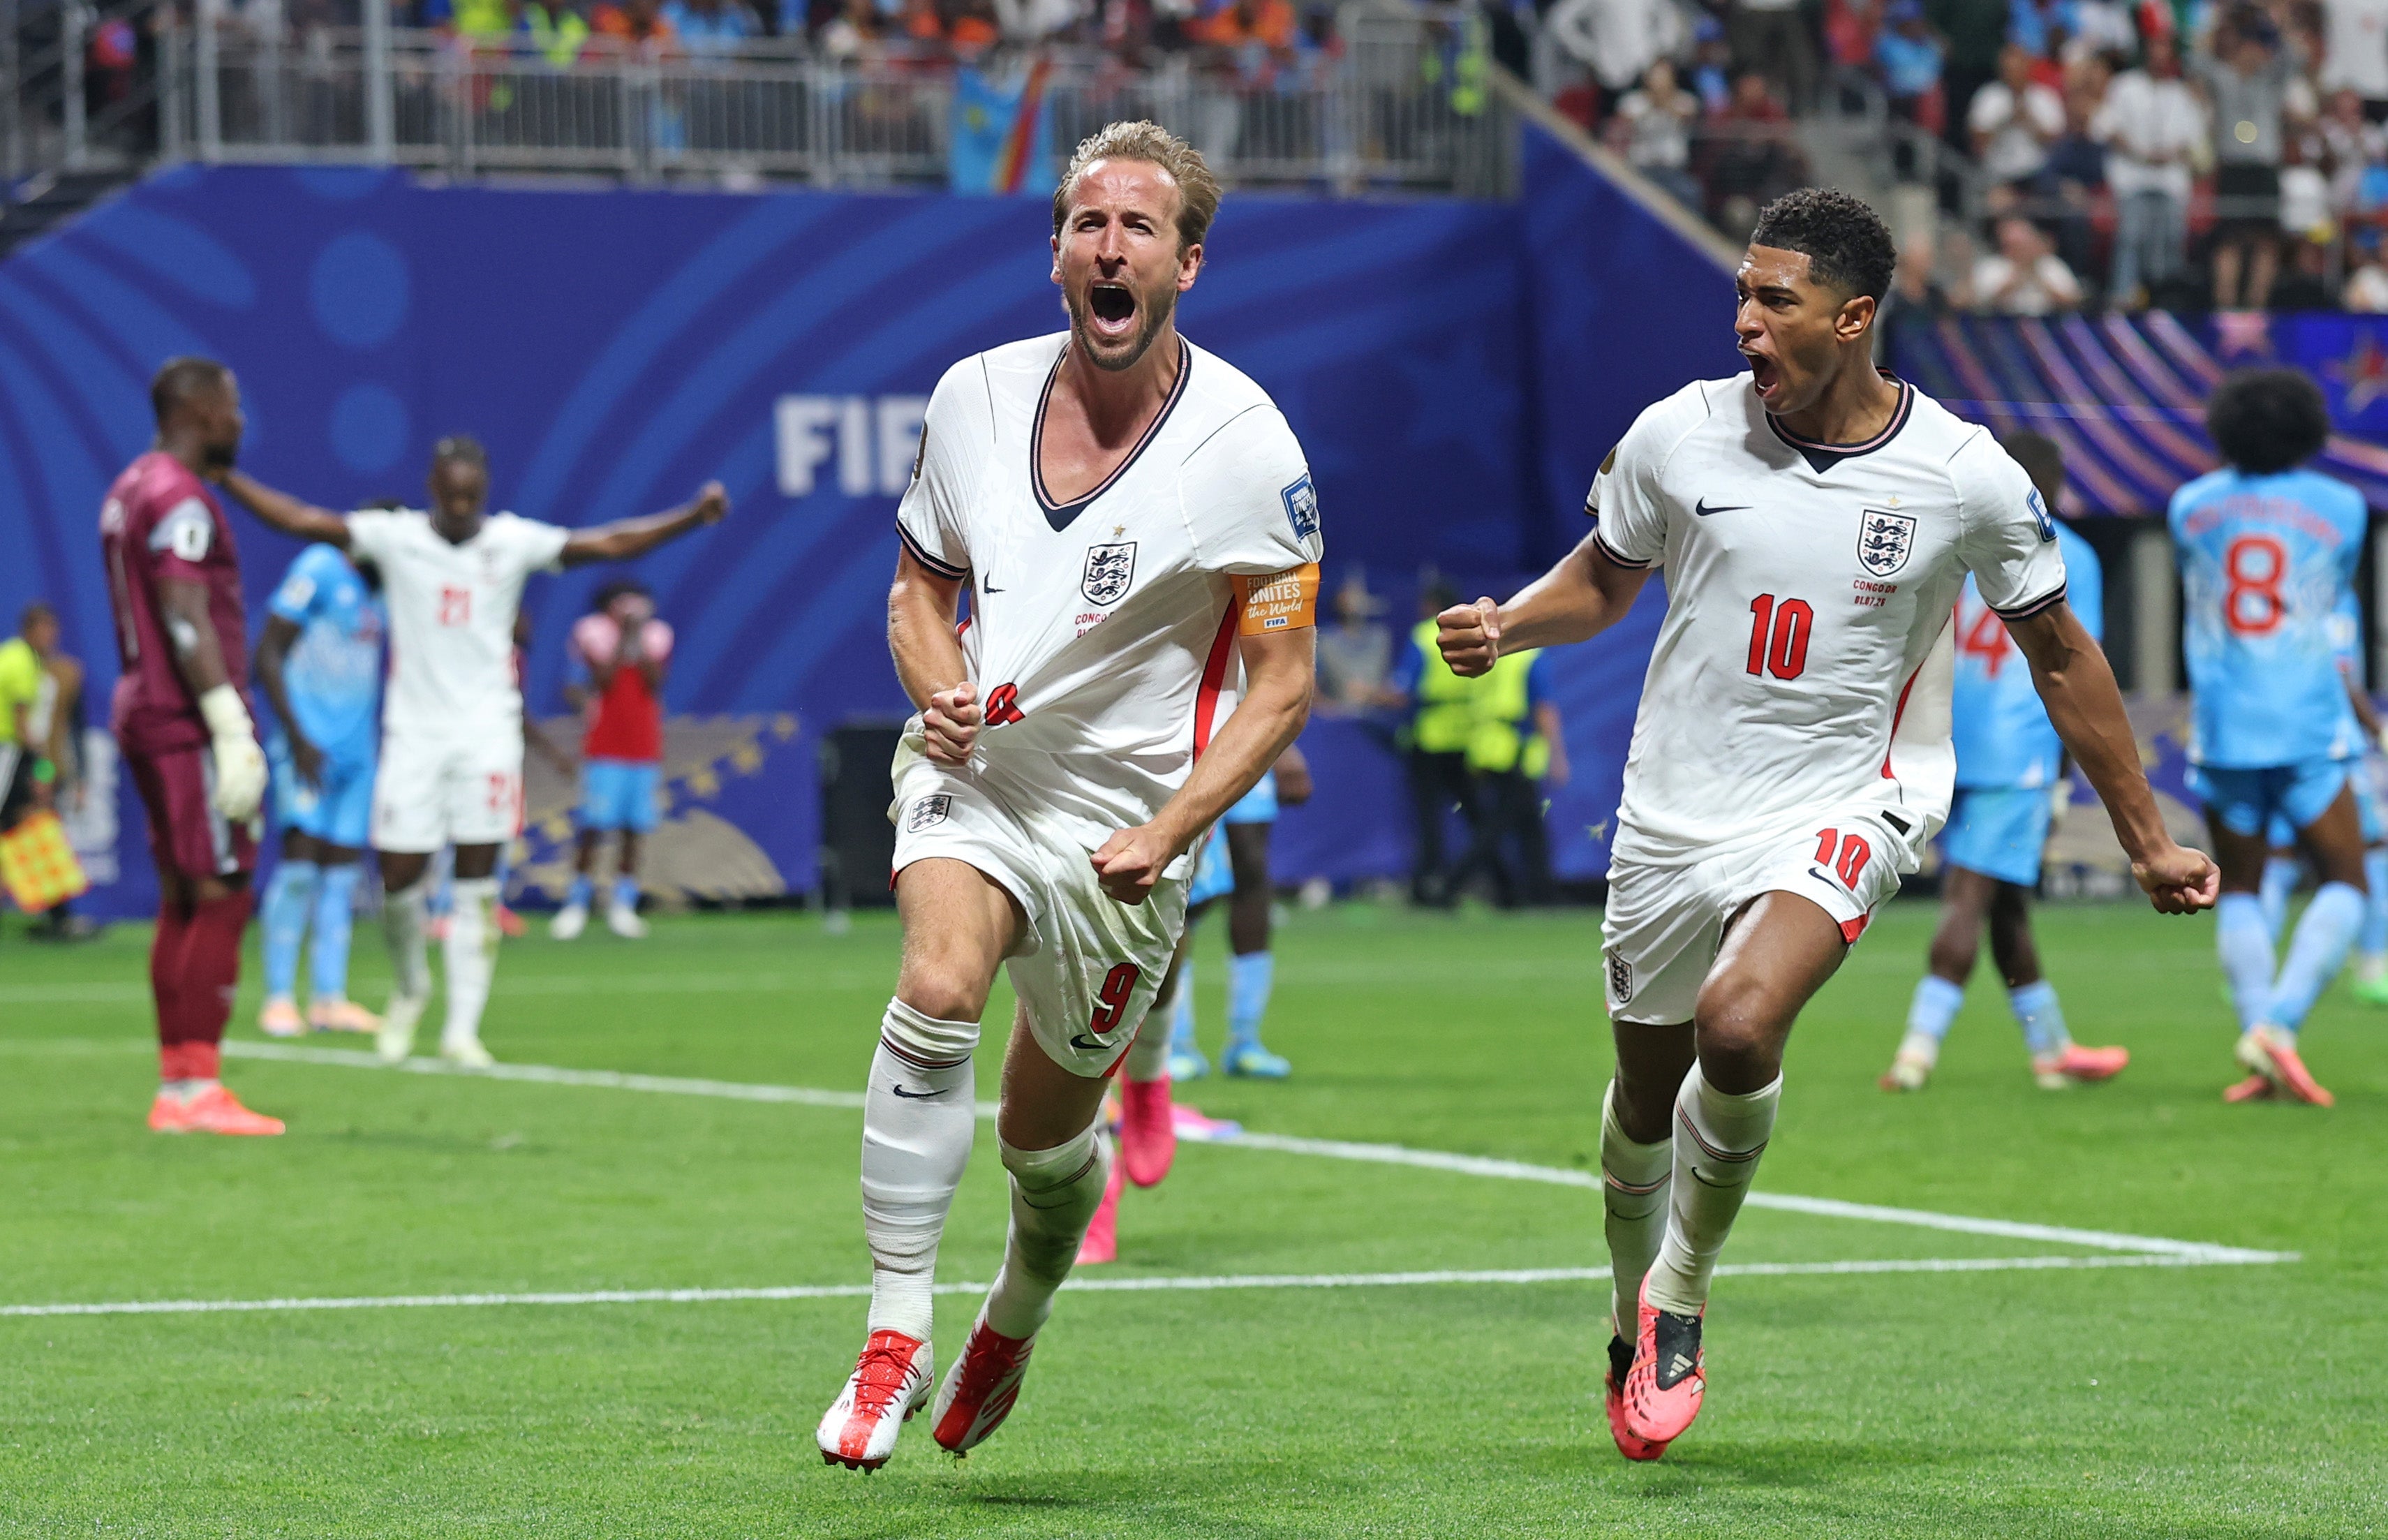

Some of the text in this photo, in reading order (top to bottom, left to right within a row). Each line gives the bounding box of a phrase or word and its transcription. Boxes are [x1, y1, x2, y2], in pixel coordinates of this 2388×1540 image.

[774, 395, 927, 497] FIF
[1247, 572, 1300, 588] FOOTBALL
[1853, 579, 1885, 593] CONGO
[2225, 534, 2289, 639] 8
[1247, 582, 1301, 605] UNITES
[1854, 595, 1886, 607] 01.07.26
[1075, 614, 1107, 625] CONGO
[1247, 599, 1303, 619] the World
[1266, 618, 1286, 627] FIFA
[1746, 593, 1814, 681] 10
[1814, 828, 1871, 891] 10
[1090, 962, 1141, 1034] 9
